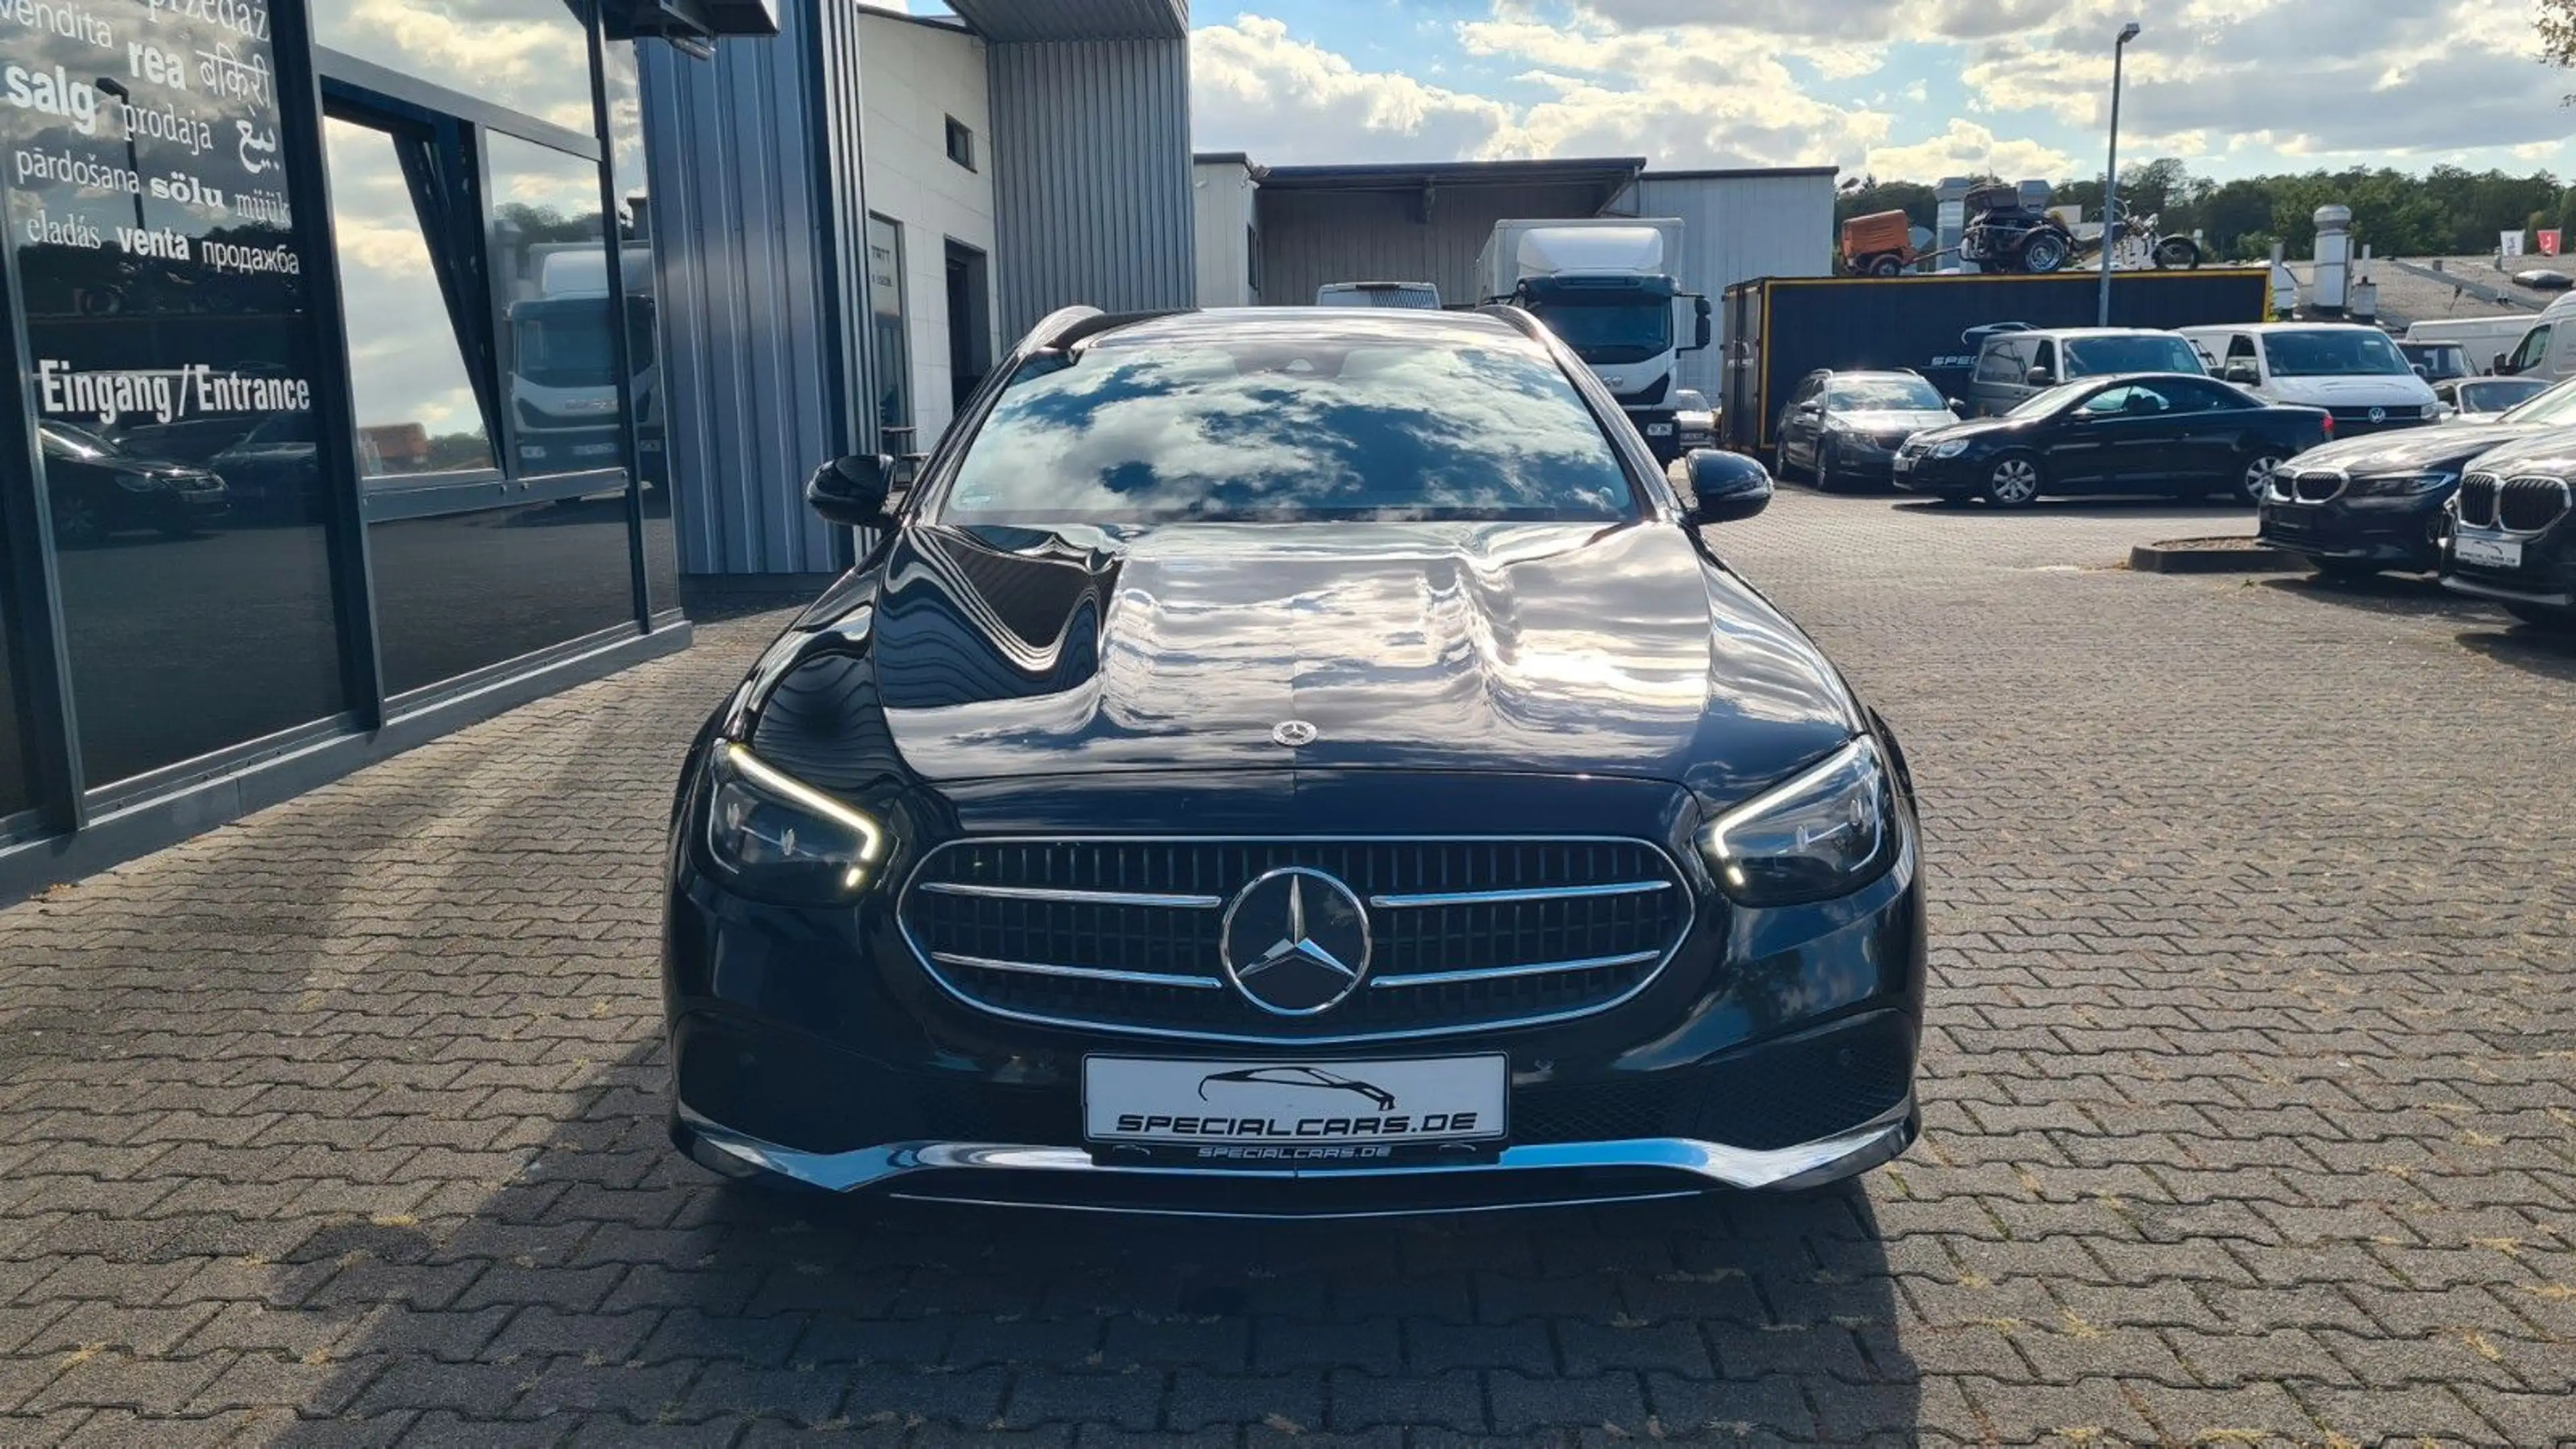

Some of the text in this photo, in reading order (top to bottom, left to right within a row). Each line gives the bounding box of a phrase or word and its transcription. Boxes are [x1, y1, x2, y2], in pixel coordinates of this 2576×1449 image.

[0, 0, 113, 48] vendita
[127, 41, 187, 91] rea
[5, 65, 97, 135] salg
[120, 104, 213, 156] prodaja
[15, 147, 292, 228] pārdošana sölu müük
[26, 209, 191, 261] eladás venta
[202, 240, 300, 275] продажба
[1116, 1112, 1479, 1136] SPECIALCARS.DE
[1197, 1146, 1392, 1159] SPECIALCARS.DE
